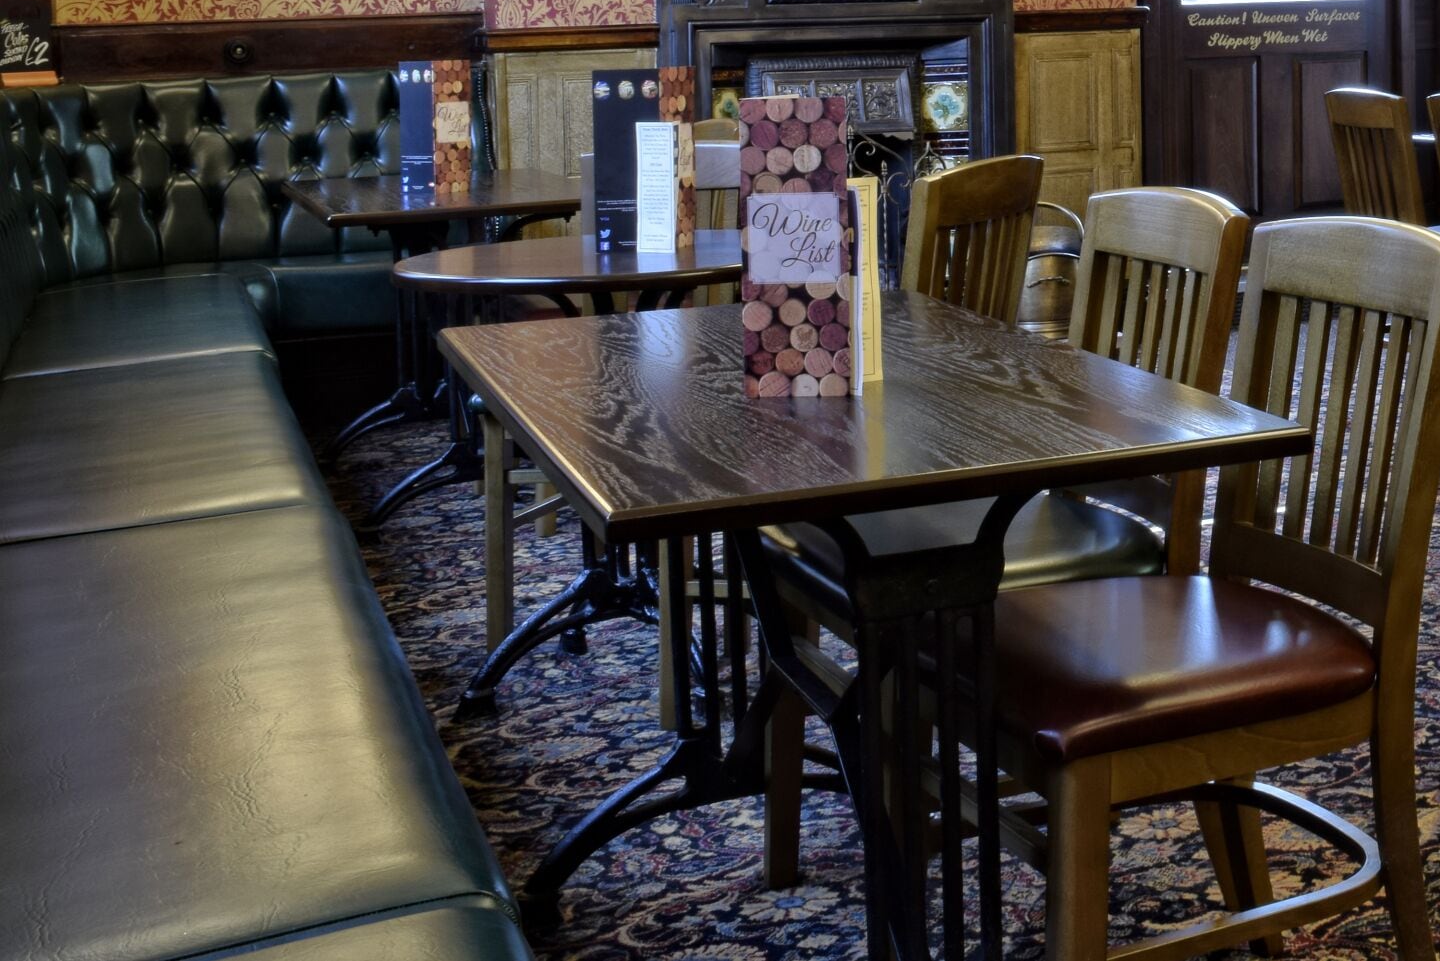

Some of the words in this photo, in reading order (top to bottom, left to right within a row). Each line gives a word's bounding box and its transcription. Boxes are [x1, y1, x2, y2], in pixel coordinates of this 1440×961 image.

[1187, 11, 1247, 27] Caution!
[1252, 10, 1300, 24] Uneven
[1305, 8, 1361, 26] Surfaces
[25, 36, 49, 66] £2
[1207, 32, 1262, 51] Slippery
[1263, 30, 1300, 45] When
[1301, 28, 1329, 43] Wet
[752, 203, 833, 238] Wine
[781, 232, 836, 274] List
